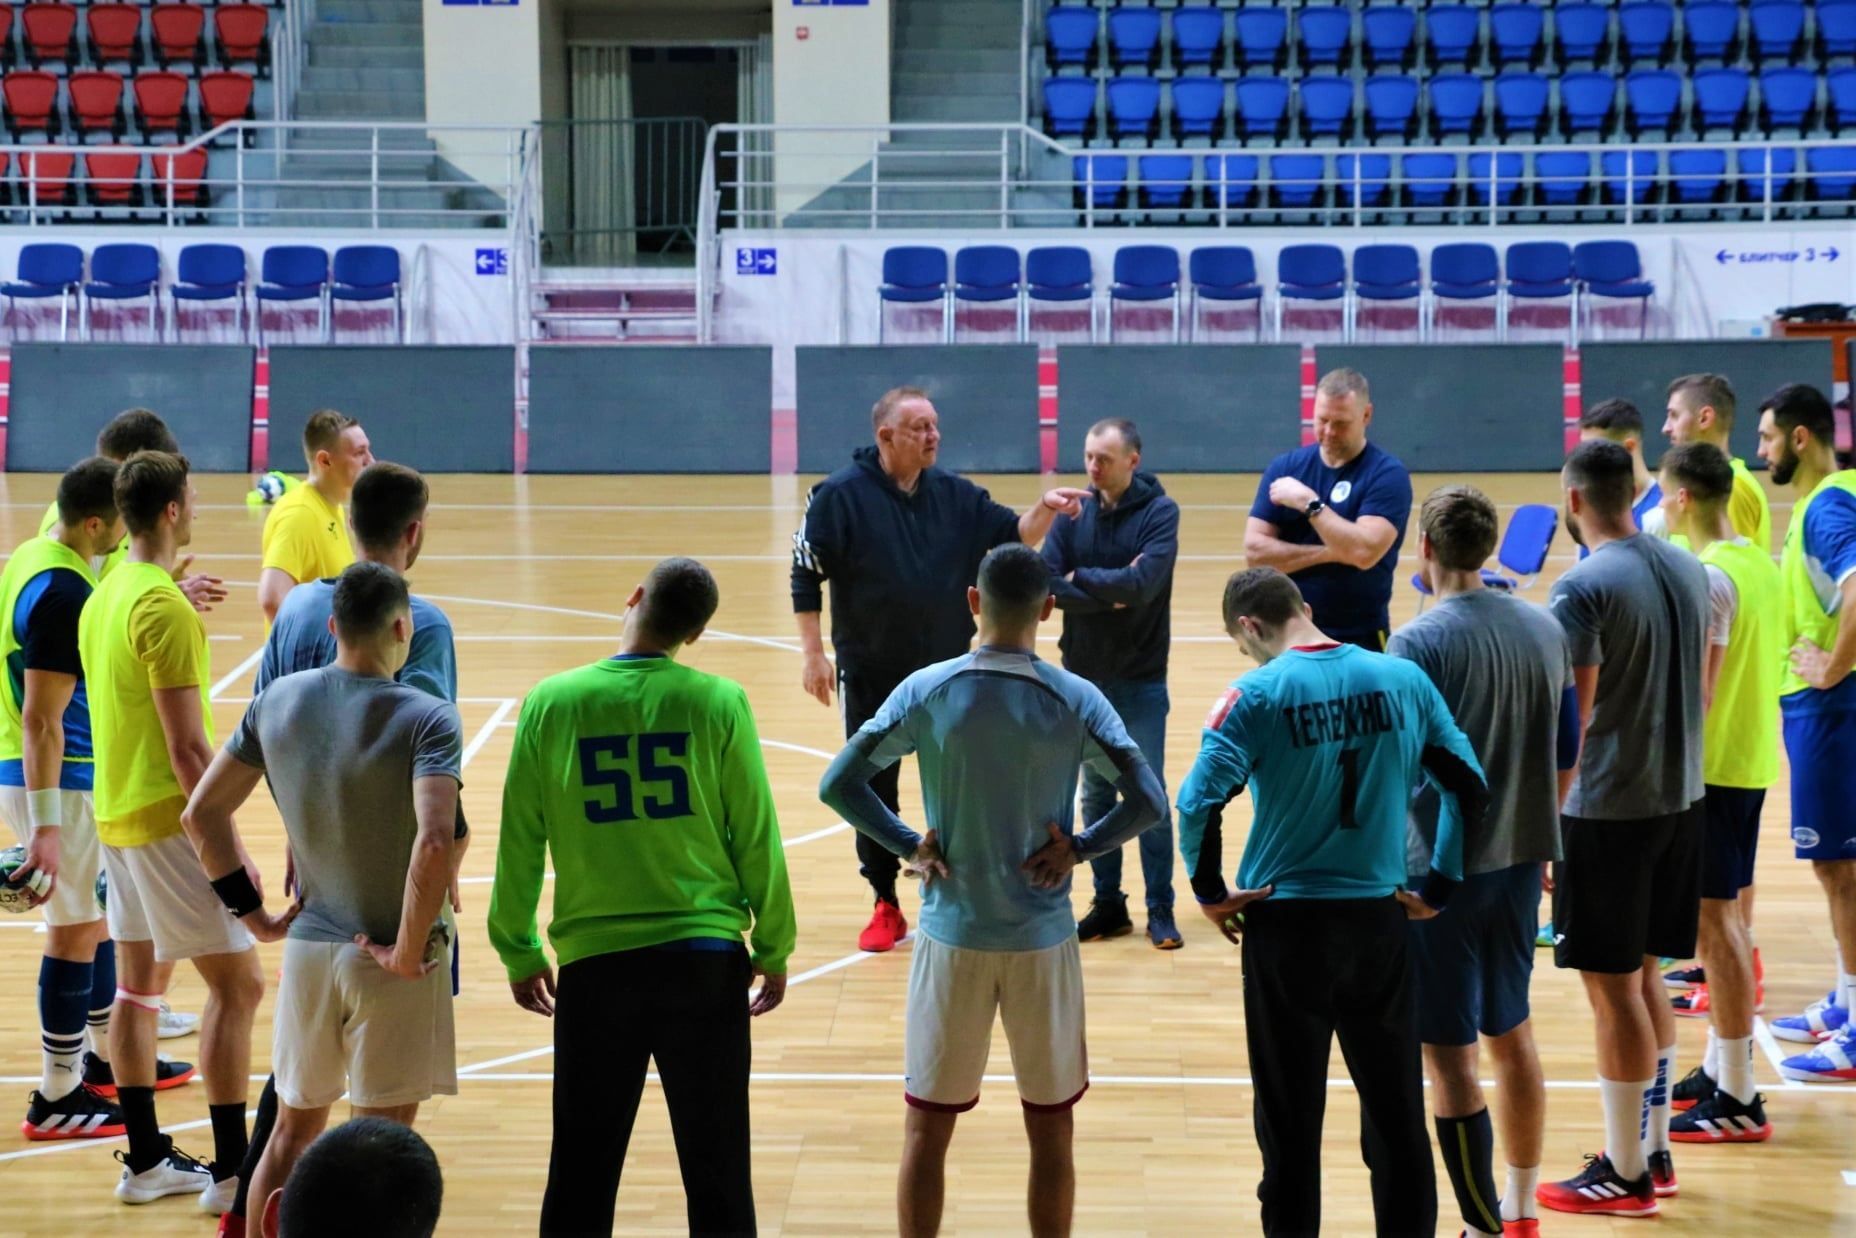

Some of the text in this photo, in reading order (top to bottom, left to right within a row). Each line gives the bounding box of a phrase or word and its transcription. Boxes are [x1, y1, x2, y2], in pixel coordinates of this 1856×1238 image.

[740, 249, 753, 266] 3
[1805, 247, 1816, 262] 3
[1283, 689, 1406, 749] TEREKHOV
[578, 731, 697, 824] 55
[1337, 748, 1362, 830] 1
